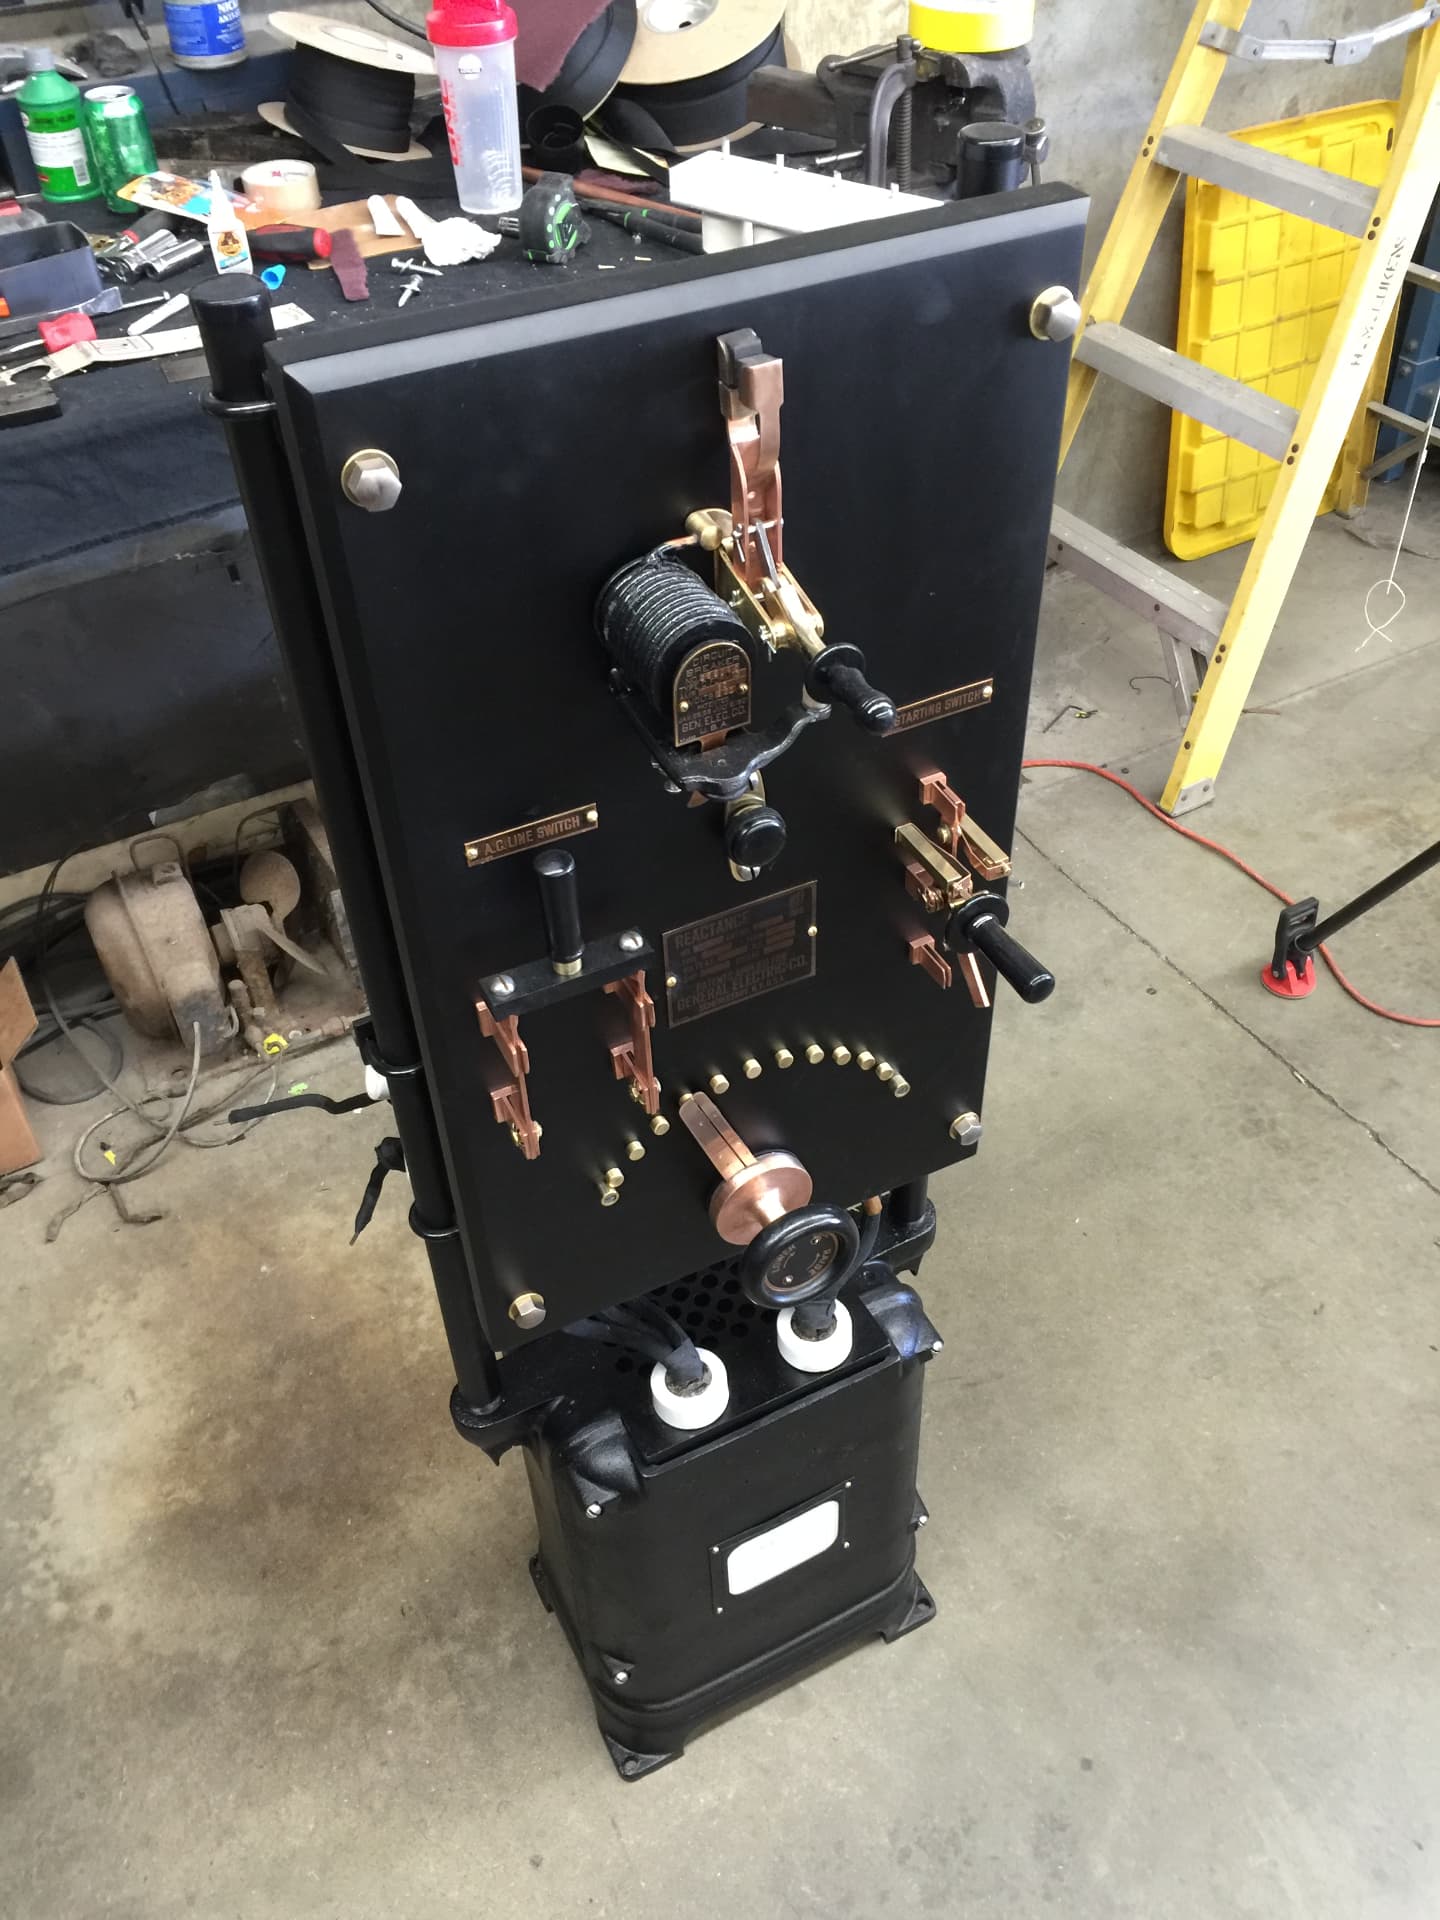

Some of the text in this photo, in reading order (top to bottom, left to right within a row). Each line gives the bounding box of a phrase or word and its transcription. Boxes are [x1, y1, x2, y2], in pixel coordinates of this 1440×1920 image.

[685, 655, 740, 678] BREAKER
[692, 648, 734, 667] CIRCUIT
[895, 690, 981, 727] STARTING SWITCH
[508, 831, 534, 848] LINE
[536, 815, 580, 839] SWITCH
[675, 911, 749, 949] REACTANCE
